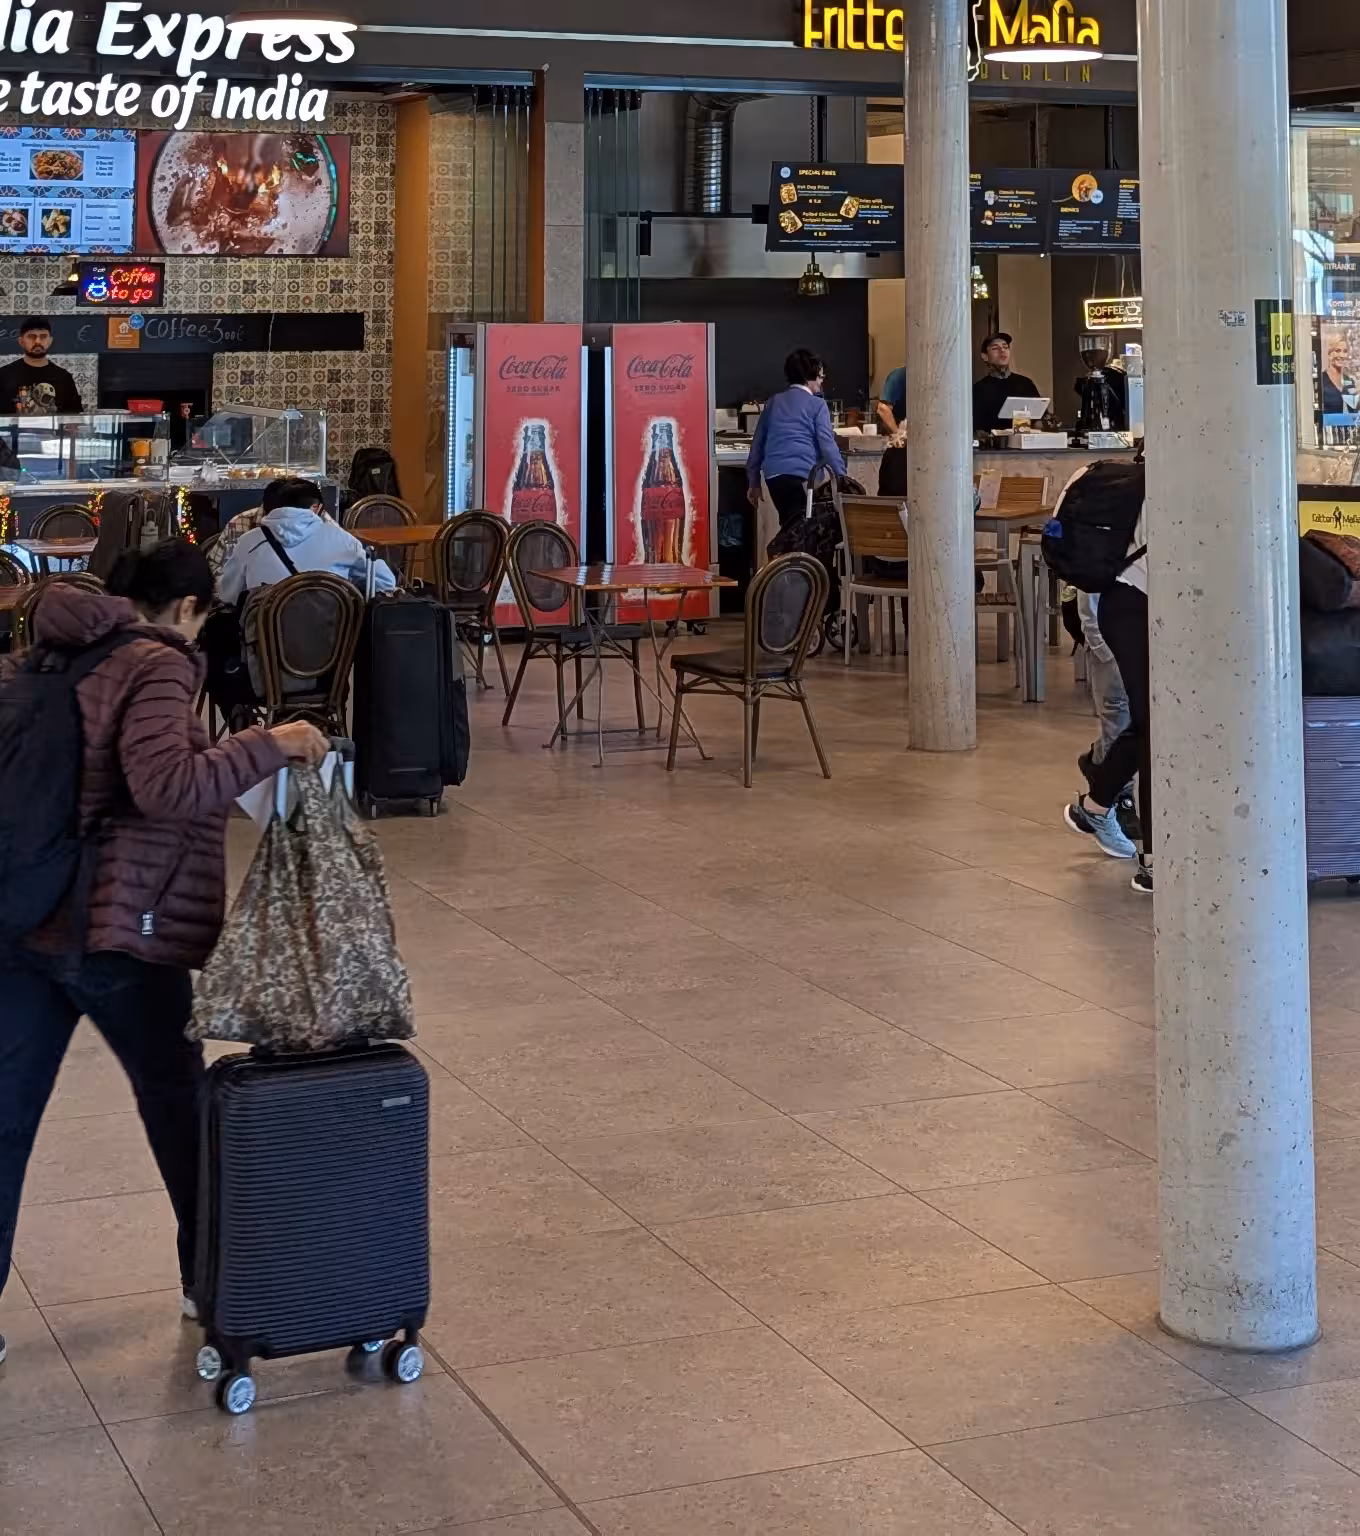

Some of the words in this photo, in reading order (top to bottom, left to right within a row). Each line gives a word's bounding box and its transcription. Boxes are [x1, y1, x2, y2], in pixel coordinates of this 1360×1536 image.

[96, 1, 358, 77] Express
[20, 69, 140, 117] taste
[150, 71, 204, 130] of
[210, 72, 328, 122] India
[109, 267, 156, 286] Coffee
[110, 284, 128, 300] to
[130, 288, 153, 304] go
[1088, 306, 1124, 316] COFFEE
[498, 354, 569, 380] Coca-Cola
[626, 353, 696, 379] Coca-Cola
